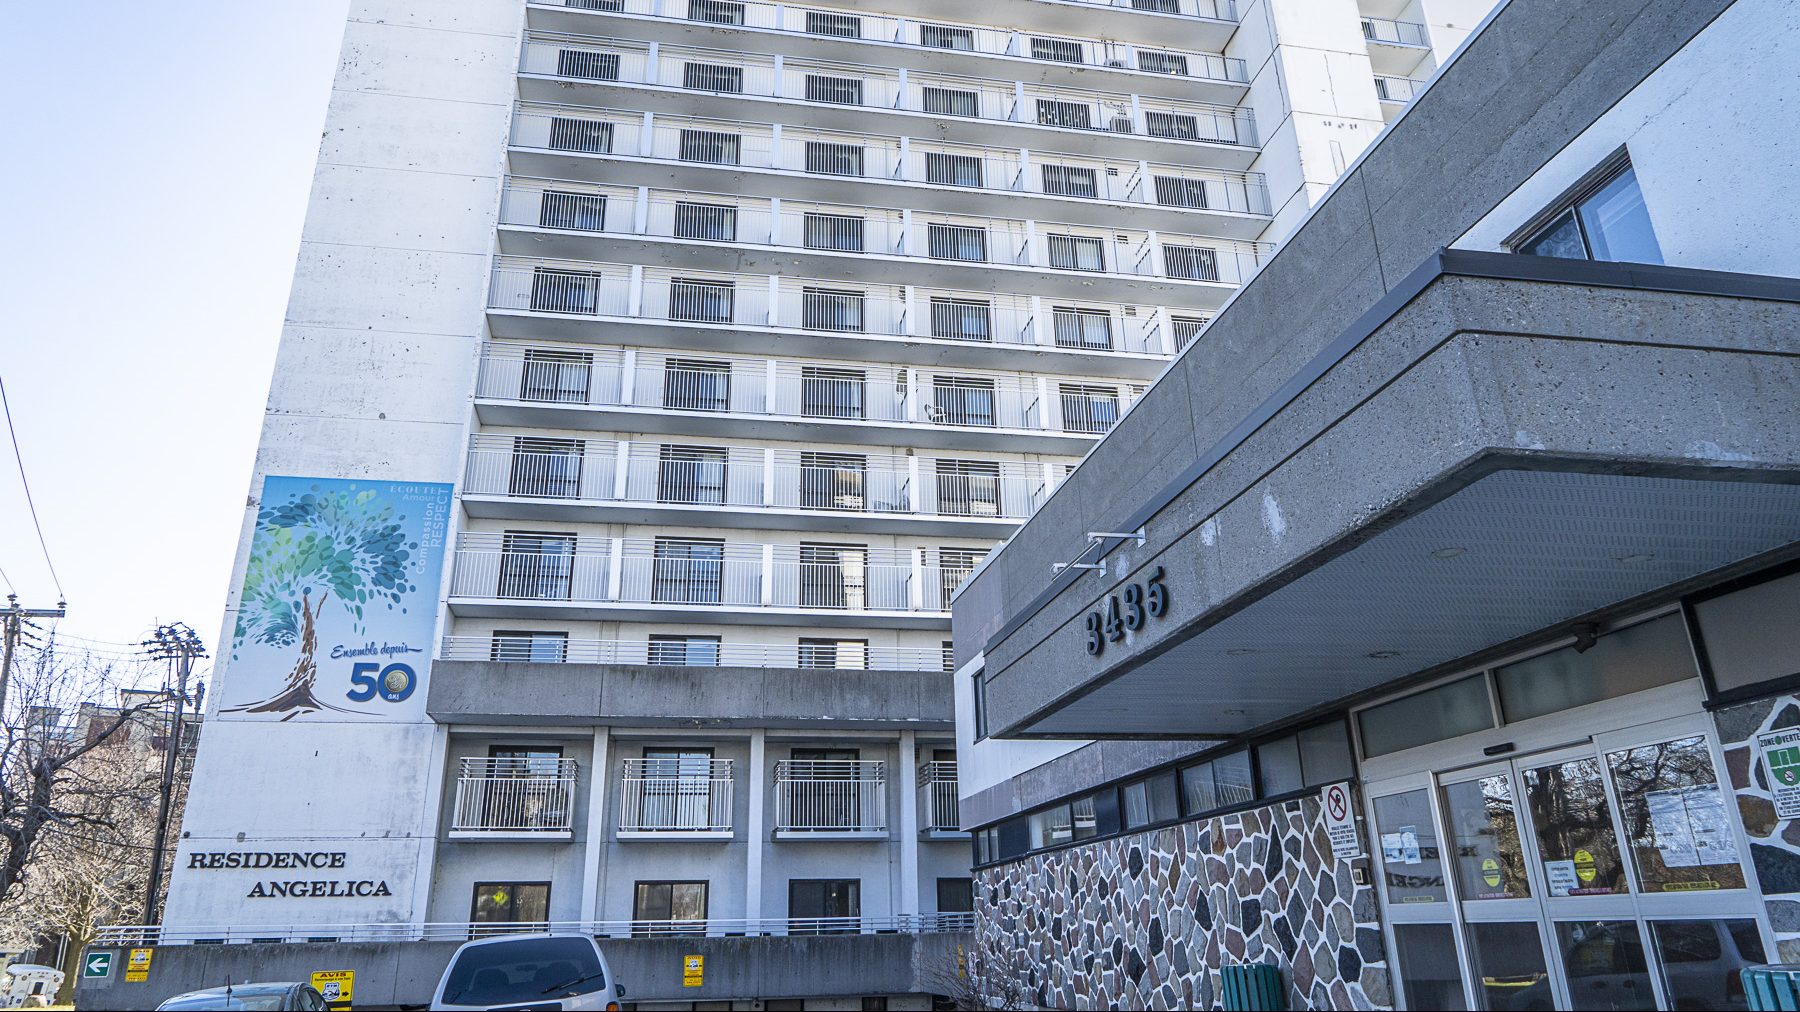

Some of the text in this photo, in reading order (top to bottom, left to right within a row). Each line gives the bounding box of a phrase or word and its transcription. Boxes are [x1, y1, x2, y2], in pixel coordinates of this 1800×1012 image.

[430, 487, 449, 547] RESPECT
[1086, 566, 1167, 655] 3435
[330, 641, 422, 659] Ensemble depuis
[346, 662, 417, 703] 50
[1760, 733, 1800, 747] ZONE VERTE
[187, 852, 346, 869] RESIDENCE
[247, 880, 392, 897] ANGELICA
